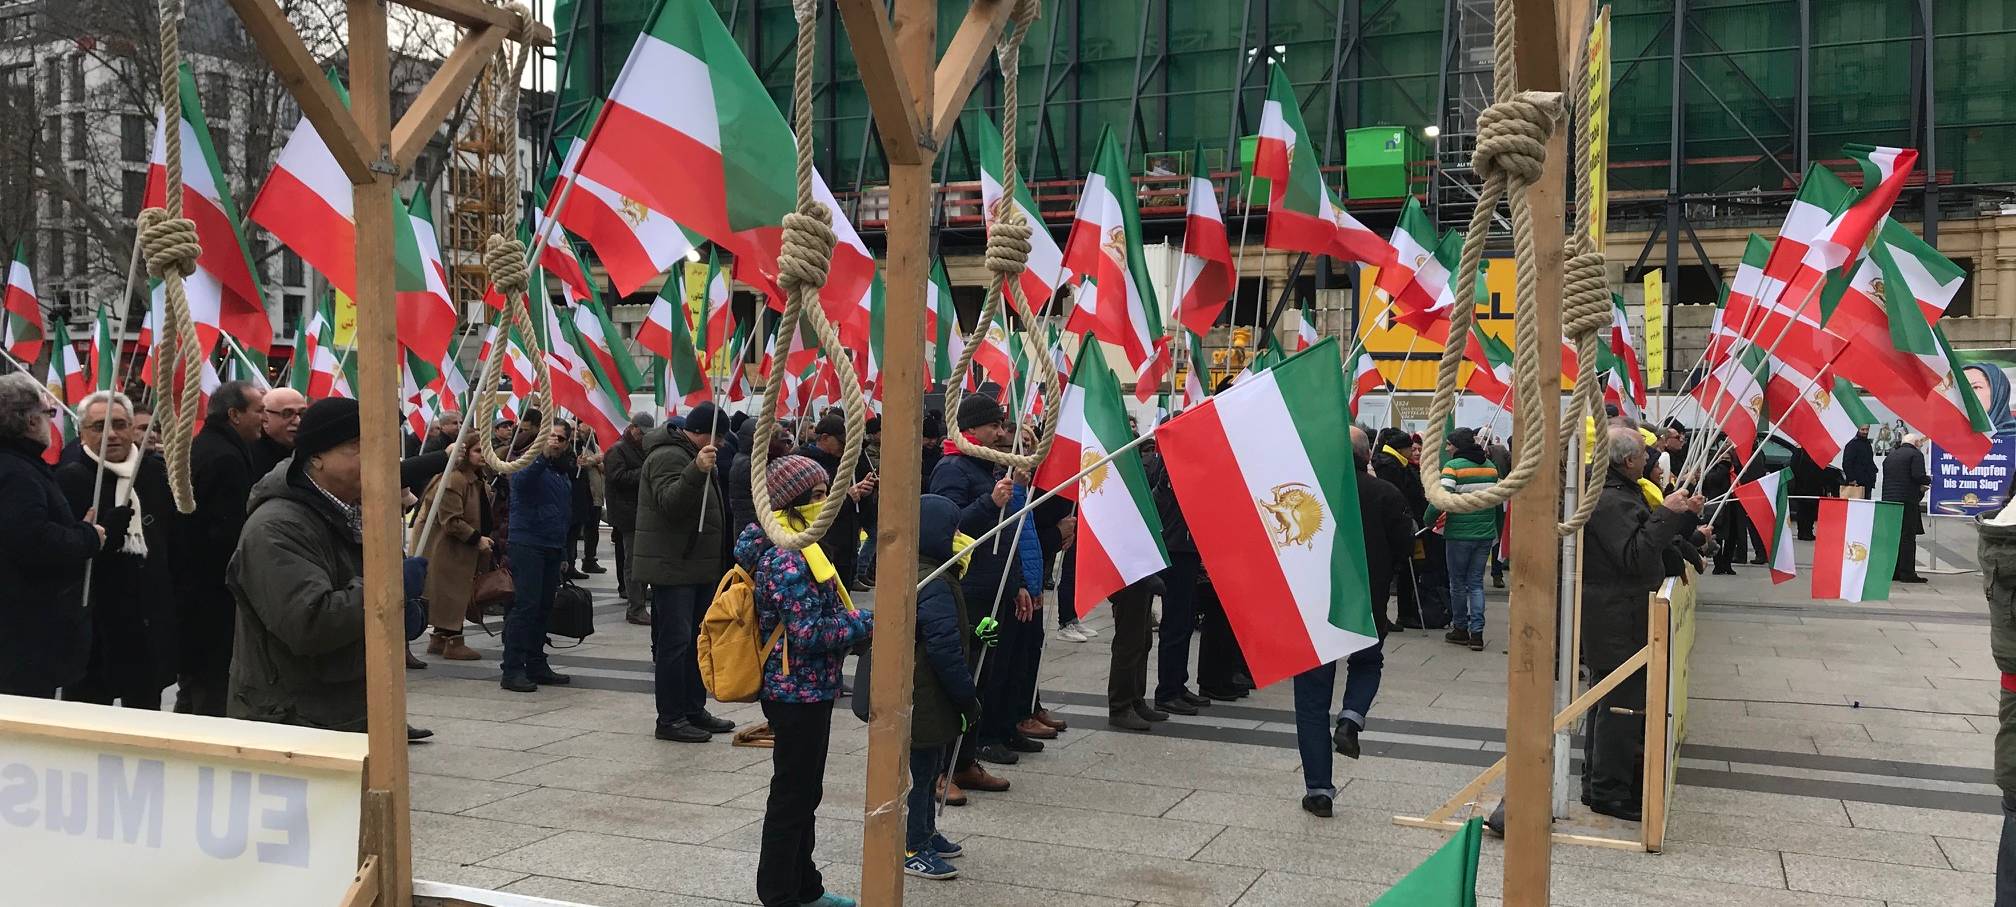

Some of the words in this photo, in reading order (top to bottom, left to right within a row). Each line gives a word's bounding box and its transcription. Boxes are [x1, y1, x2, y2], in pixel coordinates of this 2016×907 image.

[1941, 463, 1960, 476] Wir
[1943, 478, 1957, 489] bis
[1959, 480, 1977, 489] zum
